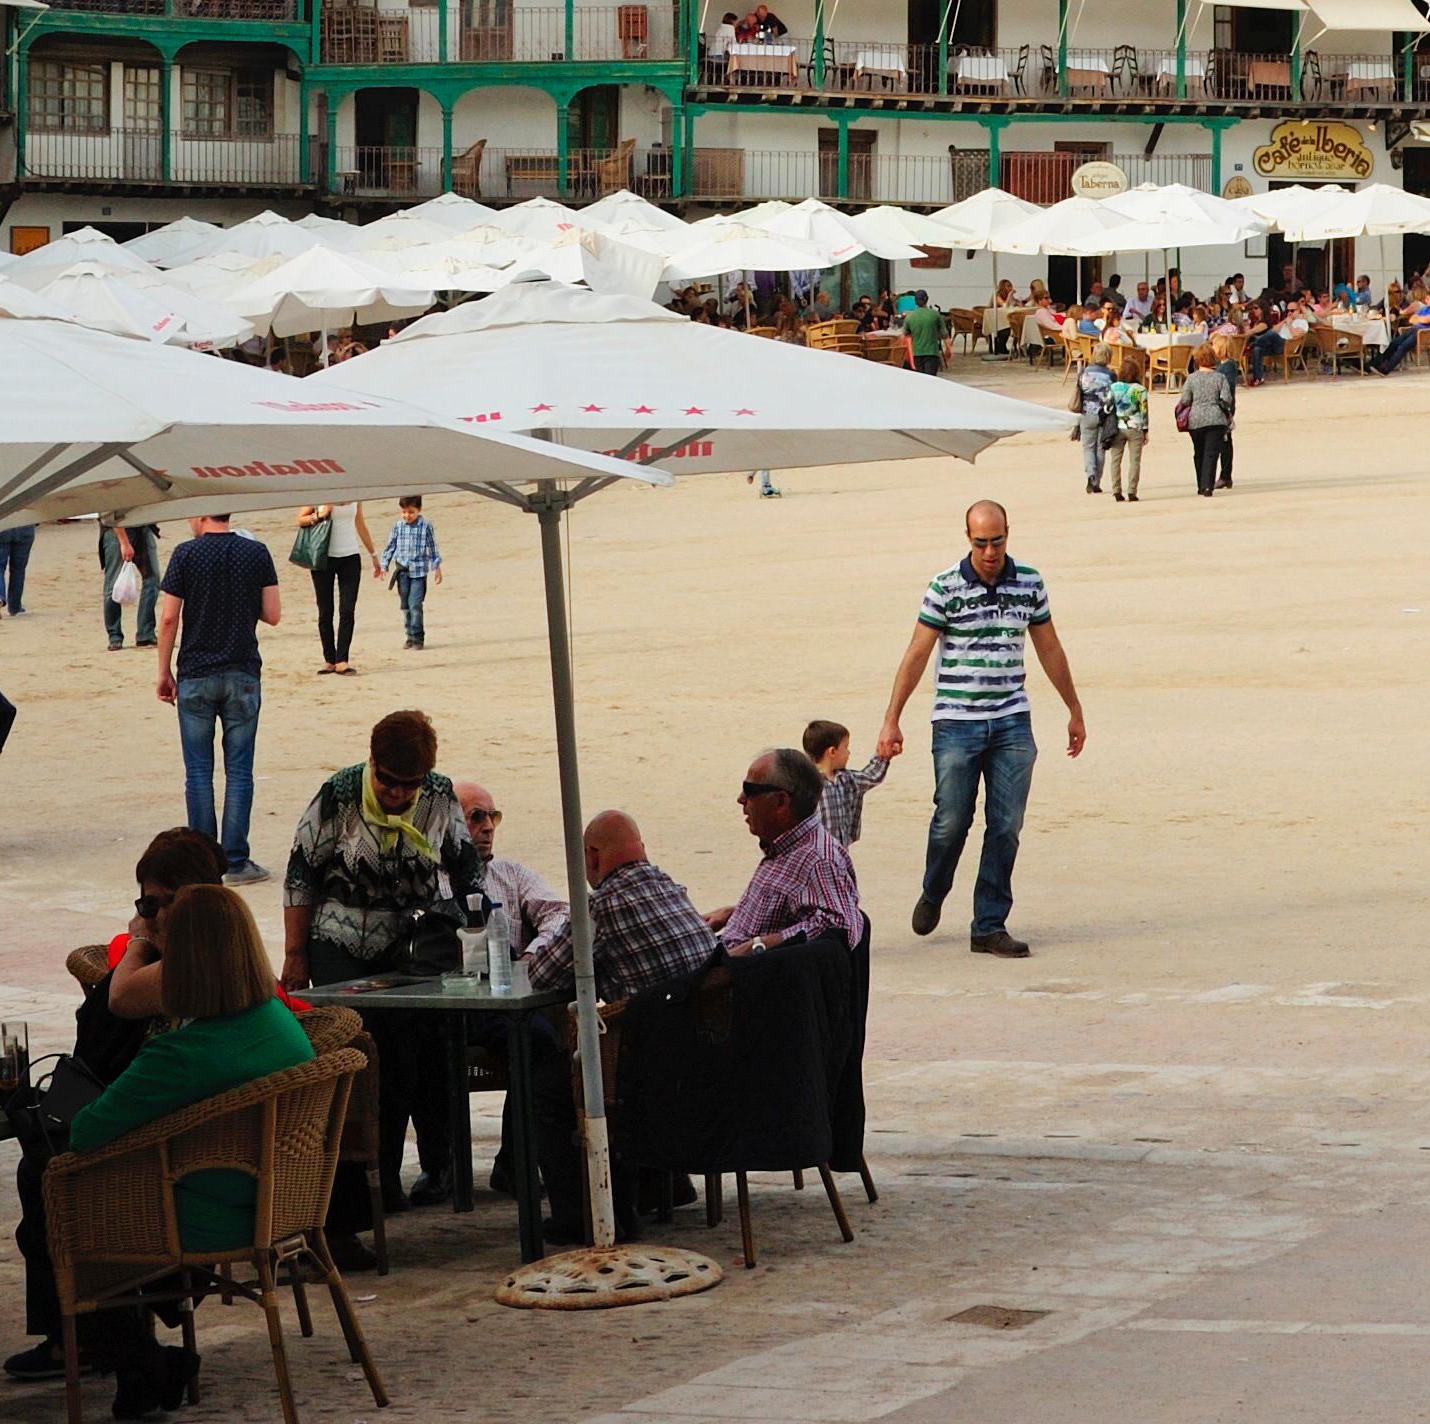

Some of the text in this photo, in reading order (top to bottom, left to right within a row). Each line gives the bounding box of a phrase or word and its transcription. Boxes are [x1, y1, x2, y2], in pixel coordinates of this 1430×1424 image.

[1258, 131, 1302, 174] Café
[1315, 126, 1371, 177] Iberia
[1079, 175, 1120, 189] Taberna
